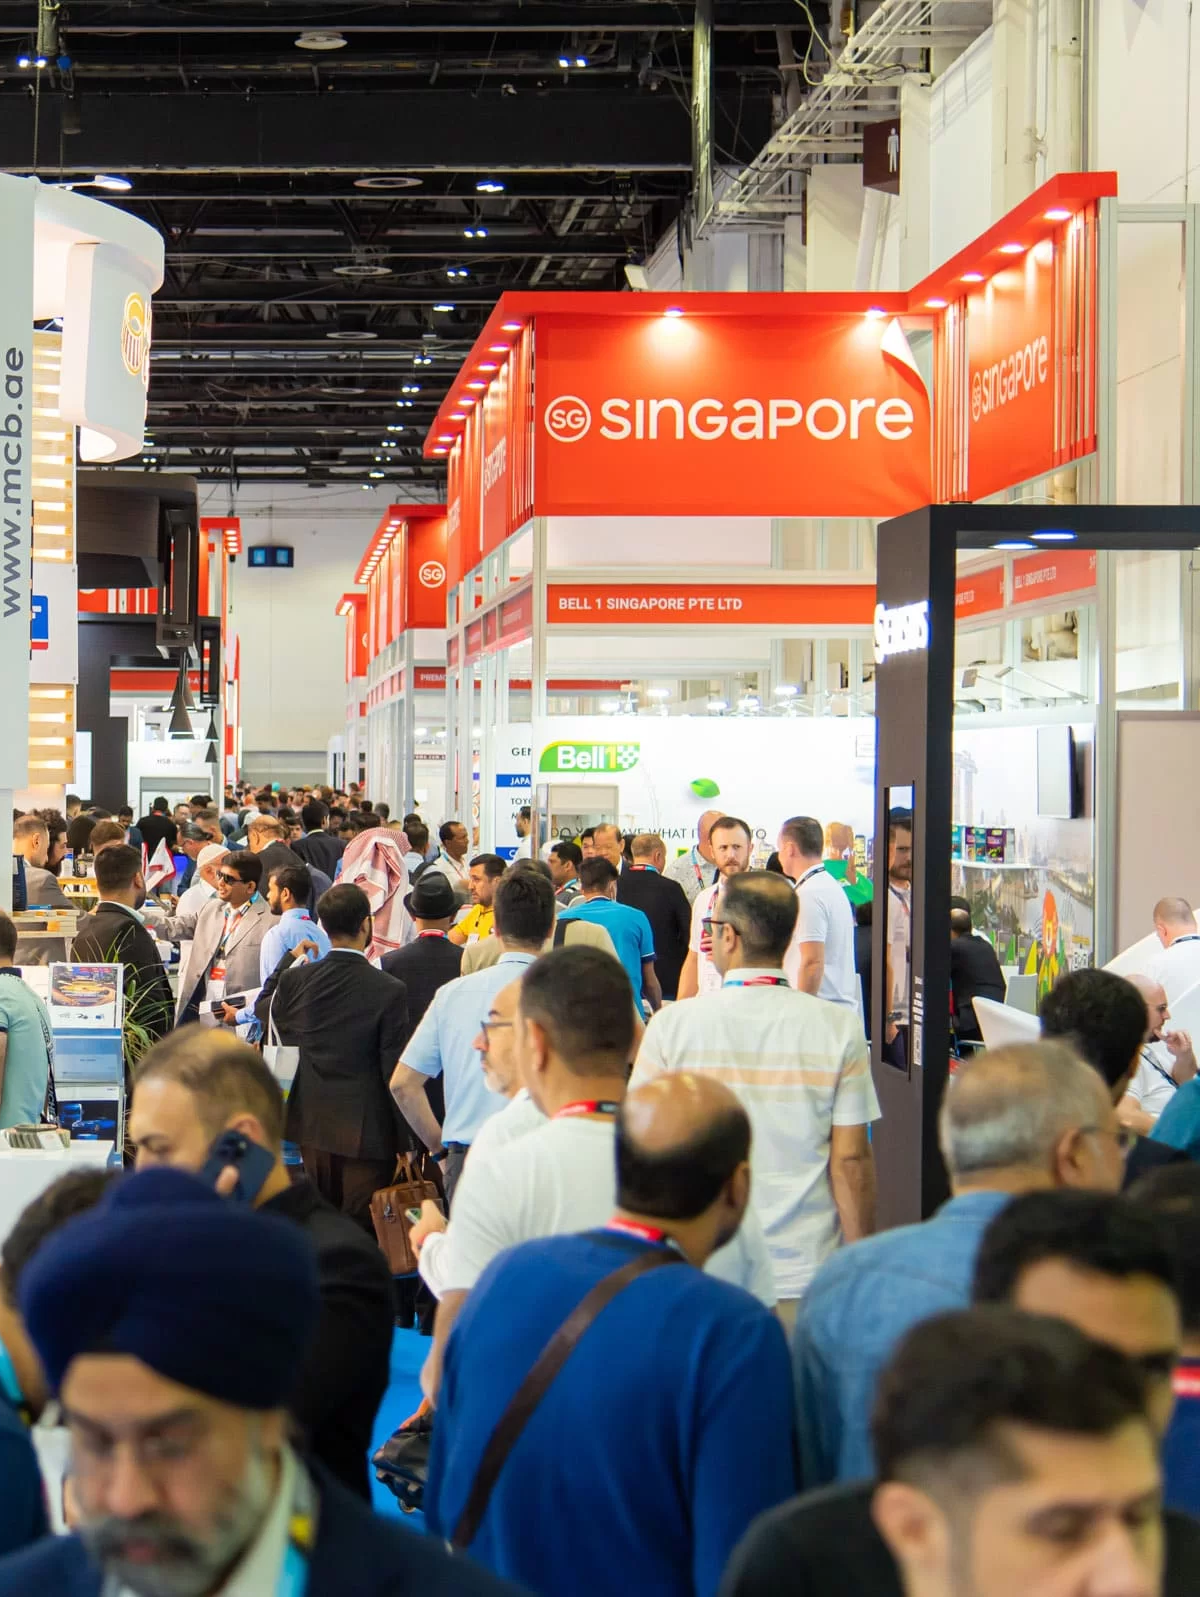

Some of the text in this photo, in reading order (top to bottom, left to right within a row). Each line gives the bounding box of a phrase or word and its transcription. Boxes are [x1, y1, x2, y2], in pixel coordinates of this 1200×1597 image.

[558, 597, 743, 610] BELL 1 SINGAPORE PTE LTD
[510, 777, 531, 786] JAPA
